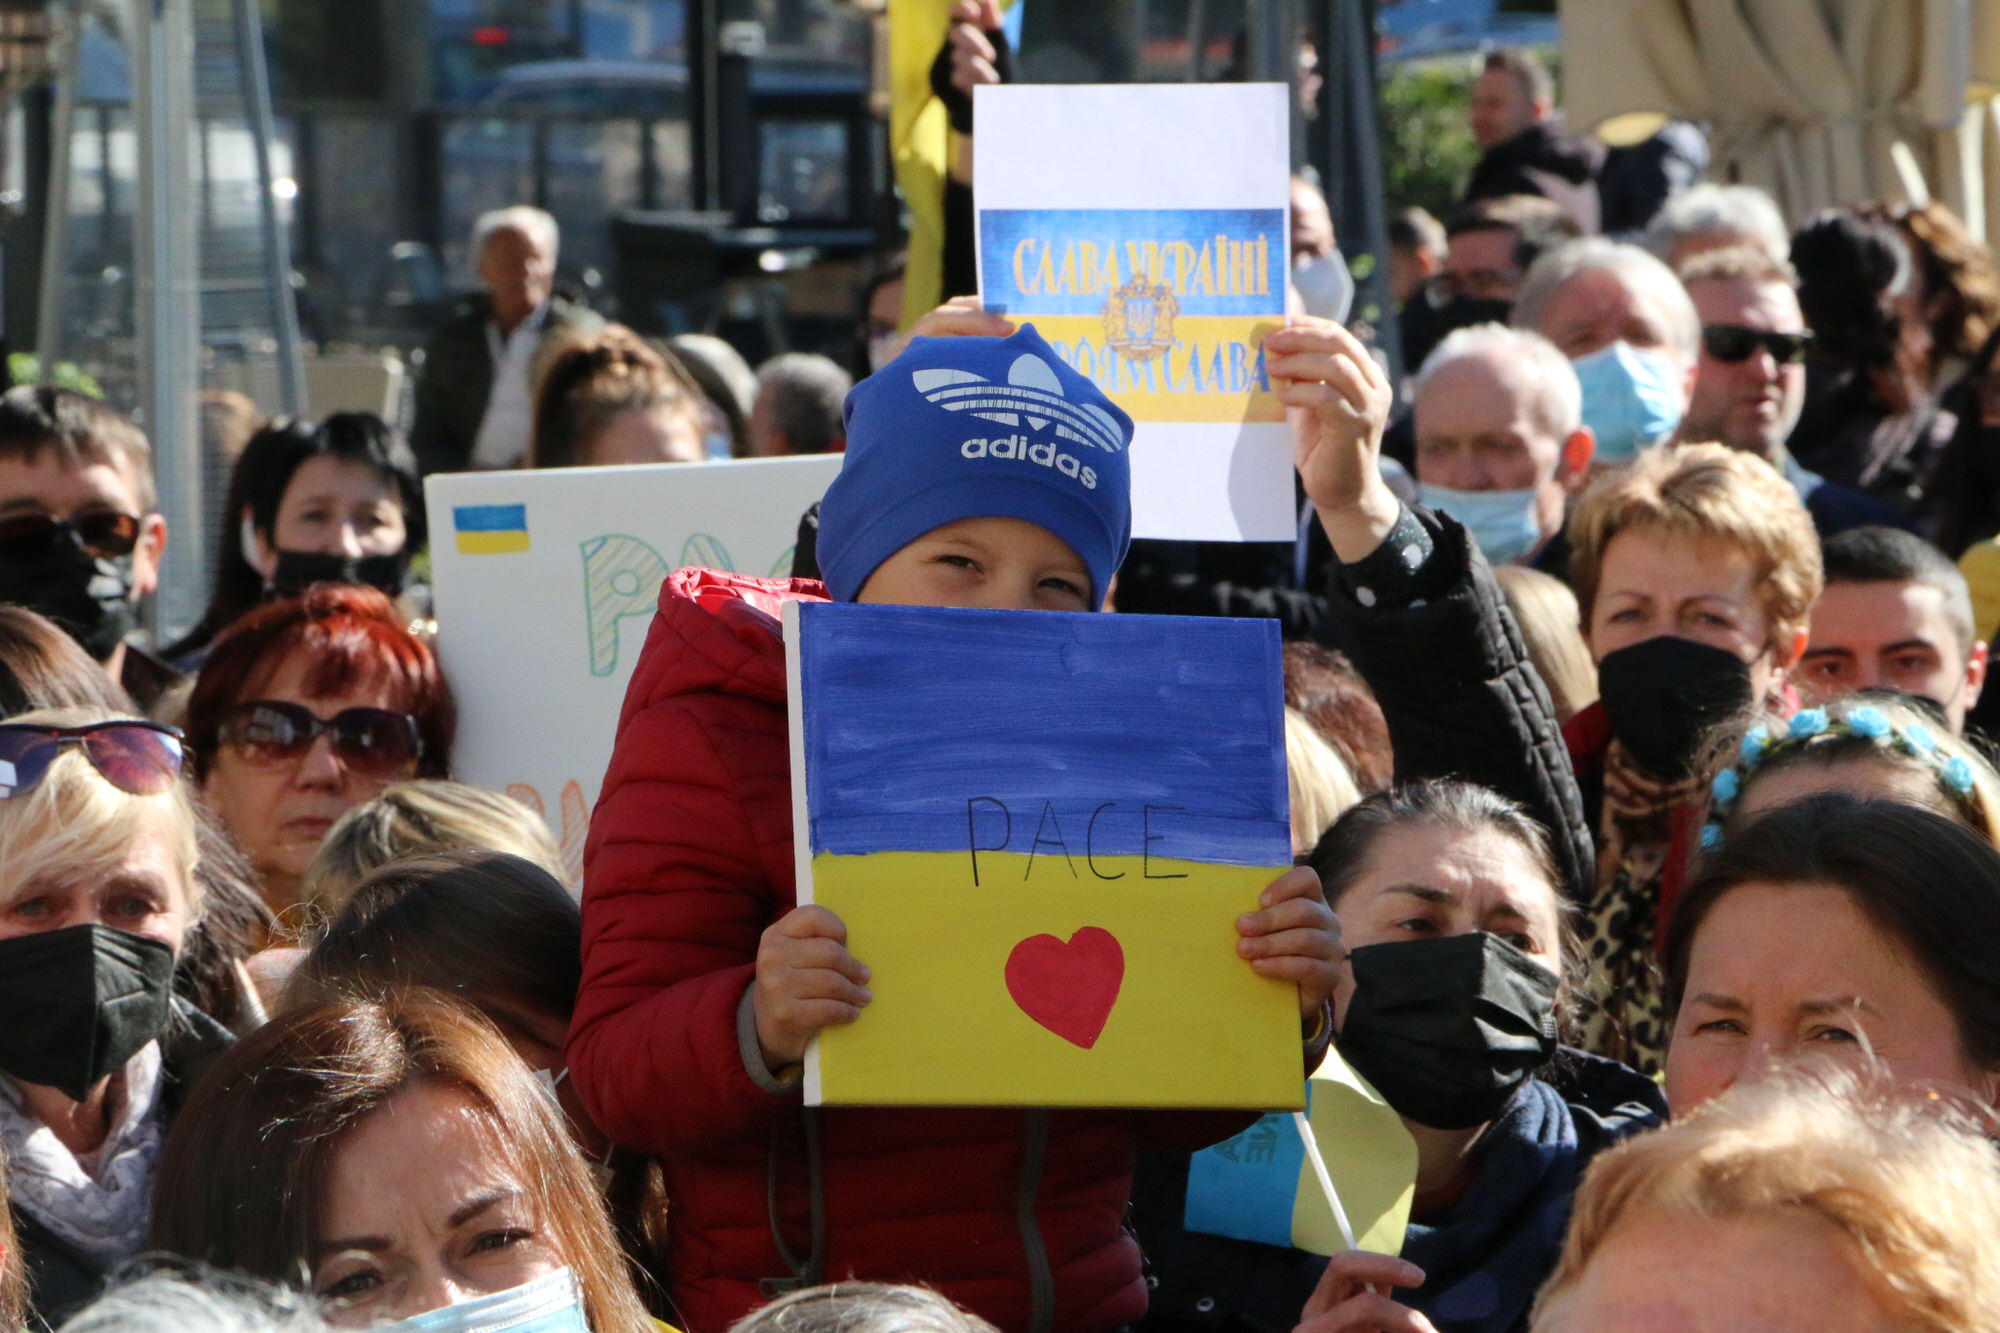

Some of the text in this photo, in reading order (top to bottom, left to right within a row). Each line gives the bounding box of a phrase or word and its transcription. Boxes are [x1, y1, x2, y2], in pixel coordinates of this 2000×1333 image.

[1012, 238, 1121, 296] СЛАВА
[1162, 339, 1271, 393] СЛАВА
[961, 434, 1098, 490] adidas
[968, 796, 1189, 887] PACE
